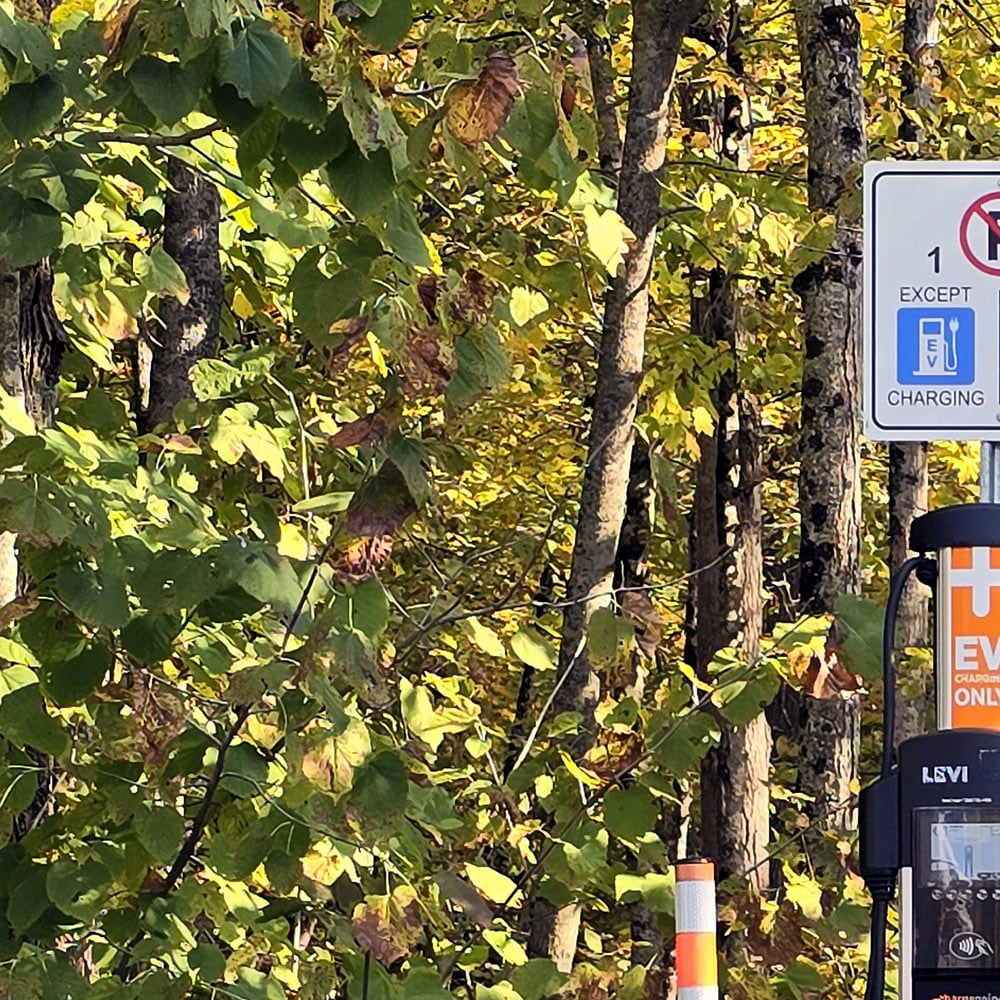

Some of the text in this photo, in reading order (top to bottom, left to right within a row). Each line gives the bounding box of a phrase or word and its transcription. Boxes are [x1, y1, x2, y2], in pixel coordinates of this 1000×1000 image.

[927, 246, 941, 274] 1
[899, 286, 972, 303] EXCEPT
[887, 390, 985, 406] CHARGING
